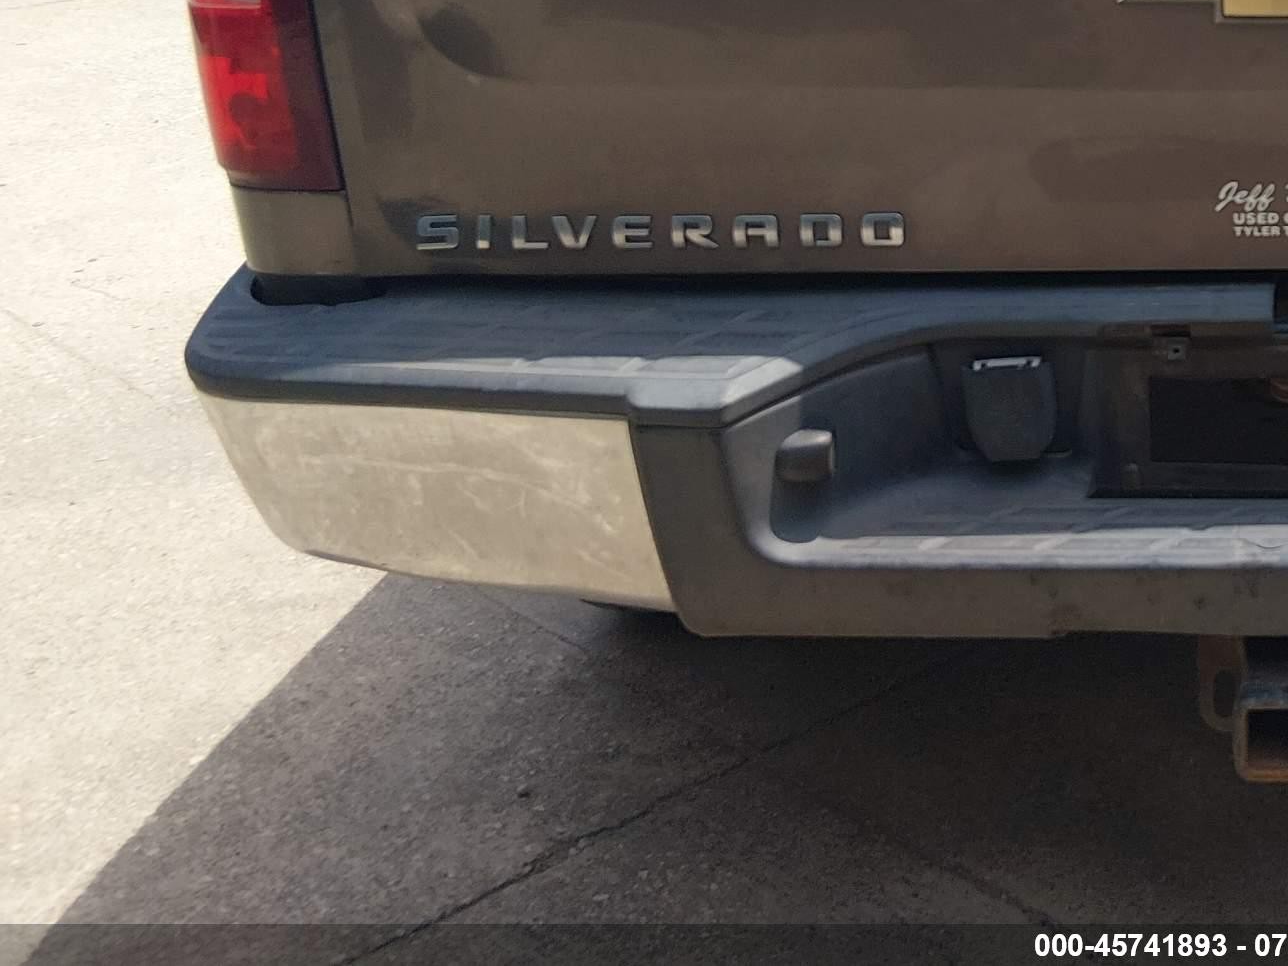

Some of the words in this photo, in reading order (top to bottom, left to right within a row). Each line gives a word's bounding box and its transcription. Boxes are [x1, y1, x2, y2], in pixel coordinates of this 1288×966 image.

[1214, 181, 1275, 212] Jeff
[1233, 212, 1280, 225] USED
[416, 212, 905, 250] SILVERADO
[1233, 225, 1281, 236] TYLER
